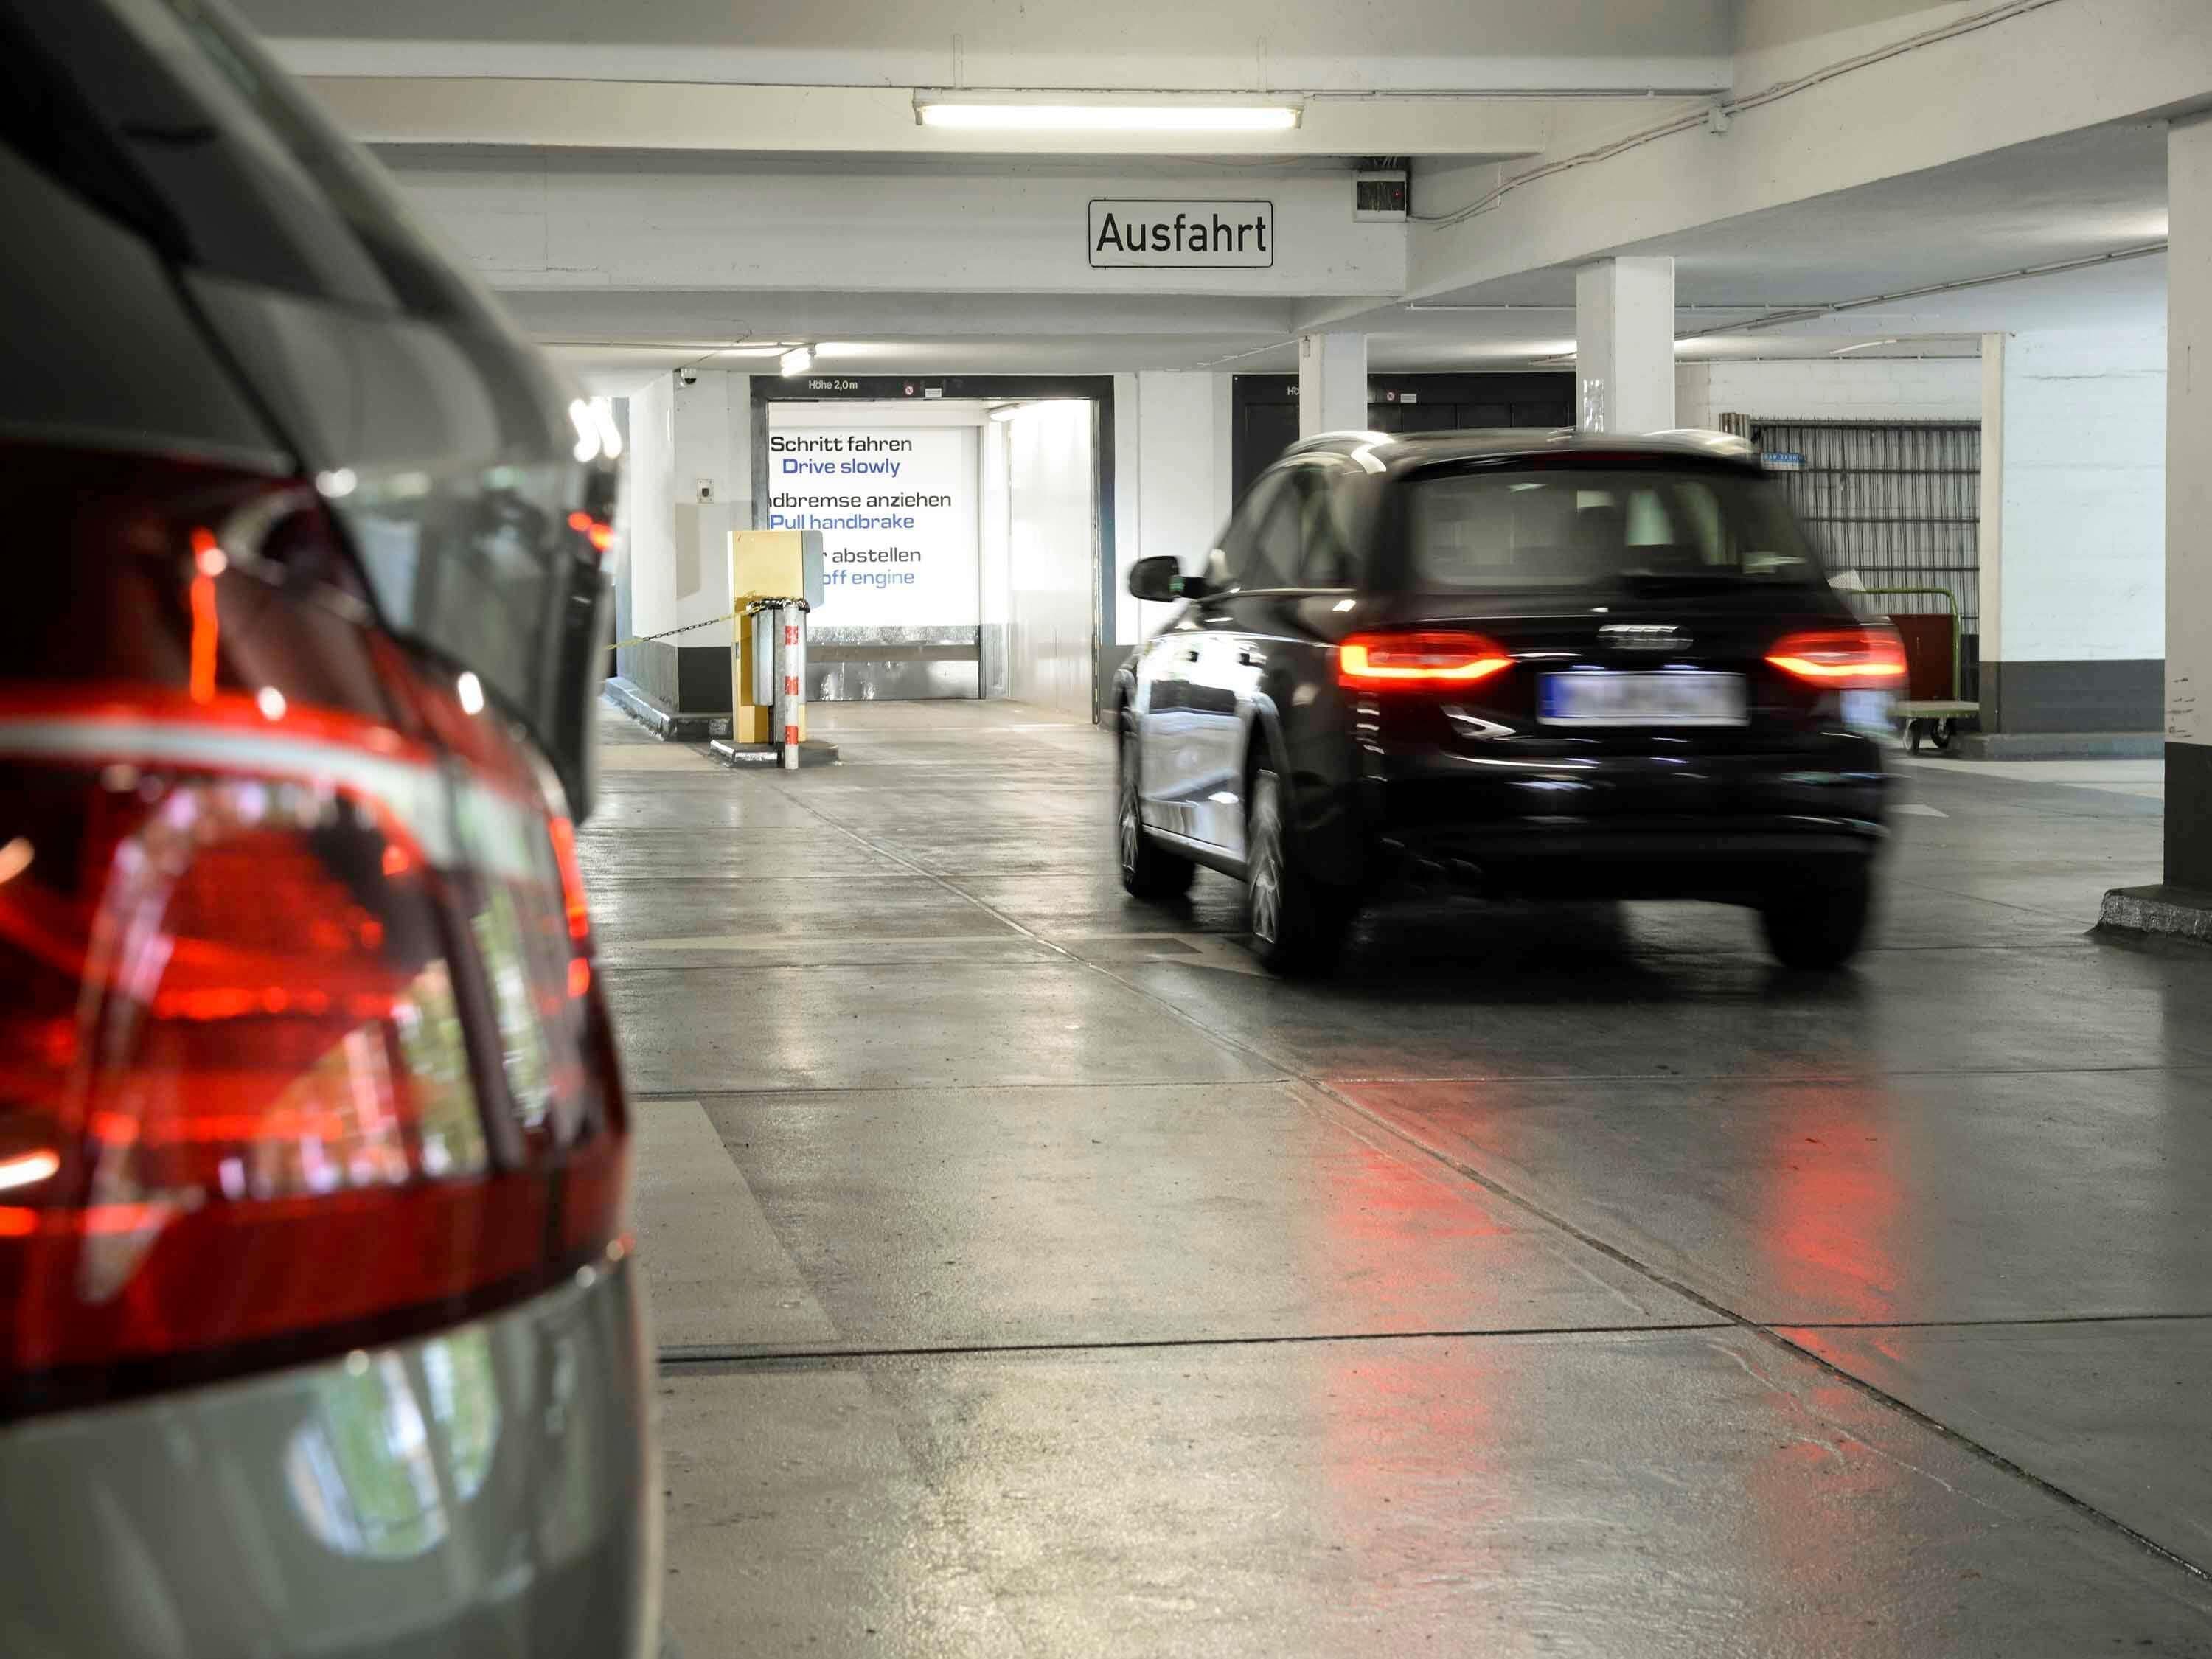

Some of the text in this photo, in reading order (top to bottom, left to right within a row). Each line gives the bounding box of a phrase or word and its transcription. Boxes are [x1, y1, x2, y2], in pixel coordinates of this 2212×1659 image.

[1096, 212, 1267, 252] Ausfahrt
[808, 379, 832, 390] Höhe
[771, 436, 913, 452] Schritt fahren
[782, 458, 900, 478] Drive slowly
[866, 492, 951, 507] anziehen
[770, 514, 915, 529] Pull handbrake
[832, 547, 922, 563] abstellen
[852, 569, 915, 589] engine
